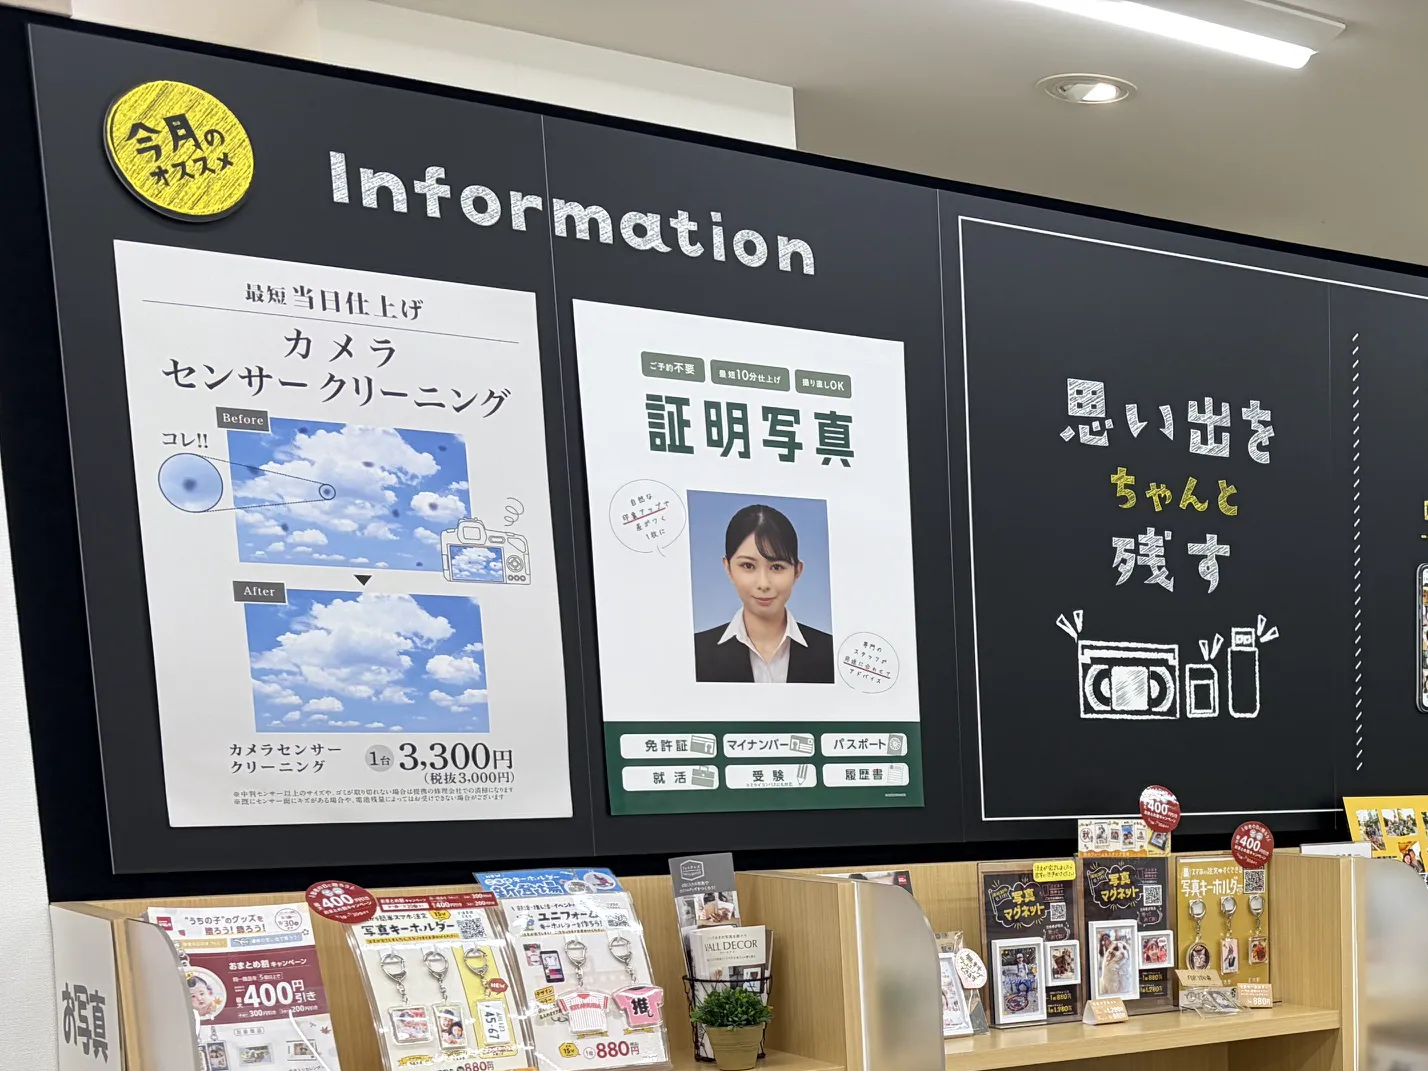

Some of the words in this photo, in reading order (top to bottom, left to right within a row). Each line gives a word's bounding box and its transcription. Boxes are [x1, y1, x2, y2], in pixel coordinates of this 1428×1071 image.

[125, 114, 224, 162] 今月の
[150, 152, 234, 187] オススメ
[328, 151, 816, 275] Information
[245, 282, 424, 321] 最短当日仕上げ
[284, 328, 396, 369] カメラ
[650, 362, 695, 376] ご予約不要
[719, 368, 781, 384] 最短10分仕上げ
[802, 378, 844, 391] 撮り直しOK
[222, 412, 264, 427] Before
[1059, 377, 1274, 464] 思い出を
[646, 393, 855, 468] 証明写真
[162, 432, 209, 450] コレ!!
[1110, 467, 1238, 516] ちゃんと
[1112, 527, 1230, 593] 残す
[243, 586, 275, 598] After
[229, 743, 342, 758] カメラセンサー
[645, 739, 688, 753] 免許証
[727, 739, 789, 751] マイナンバー
[833, 738, 886, 750] パスポート
[399, 742, 513, 770] 3,300円
[231, 760, 326, 774] クリーニング
[424, 772, 515, 785] (税抜3,000円)
[653, 771, 687, 784] 就活
[752, 770, 785, 782] 受験
[845, 769, 883, 781] 履歴書
[1147, 803, 1168, 815] 400
[1239, 837, 1261, 851] 400
[1108, 872, 1131, 886] 写真
[322, 894, 354, 908] 400
[1012, 889, 1035, 904] 写真
[1101, 887, 1139, 902] マグネット
[538, 910, 598, 921] ユニフォーム
[1004, 903, 1045, 920] マグネット
[361, 920, 455, 937] 写真キーホルダー
[723, 939, 758, 951] DECOR
[292, 980, 305, 991] 円
[243, 982, 293, 1008] 400
[61, 981, 108, 1064] お写真
